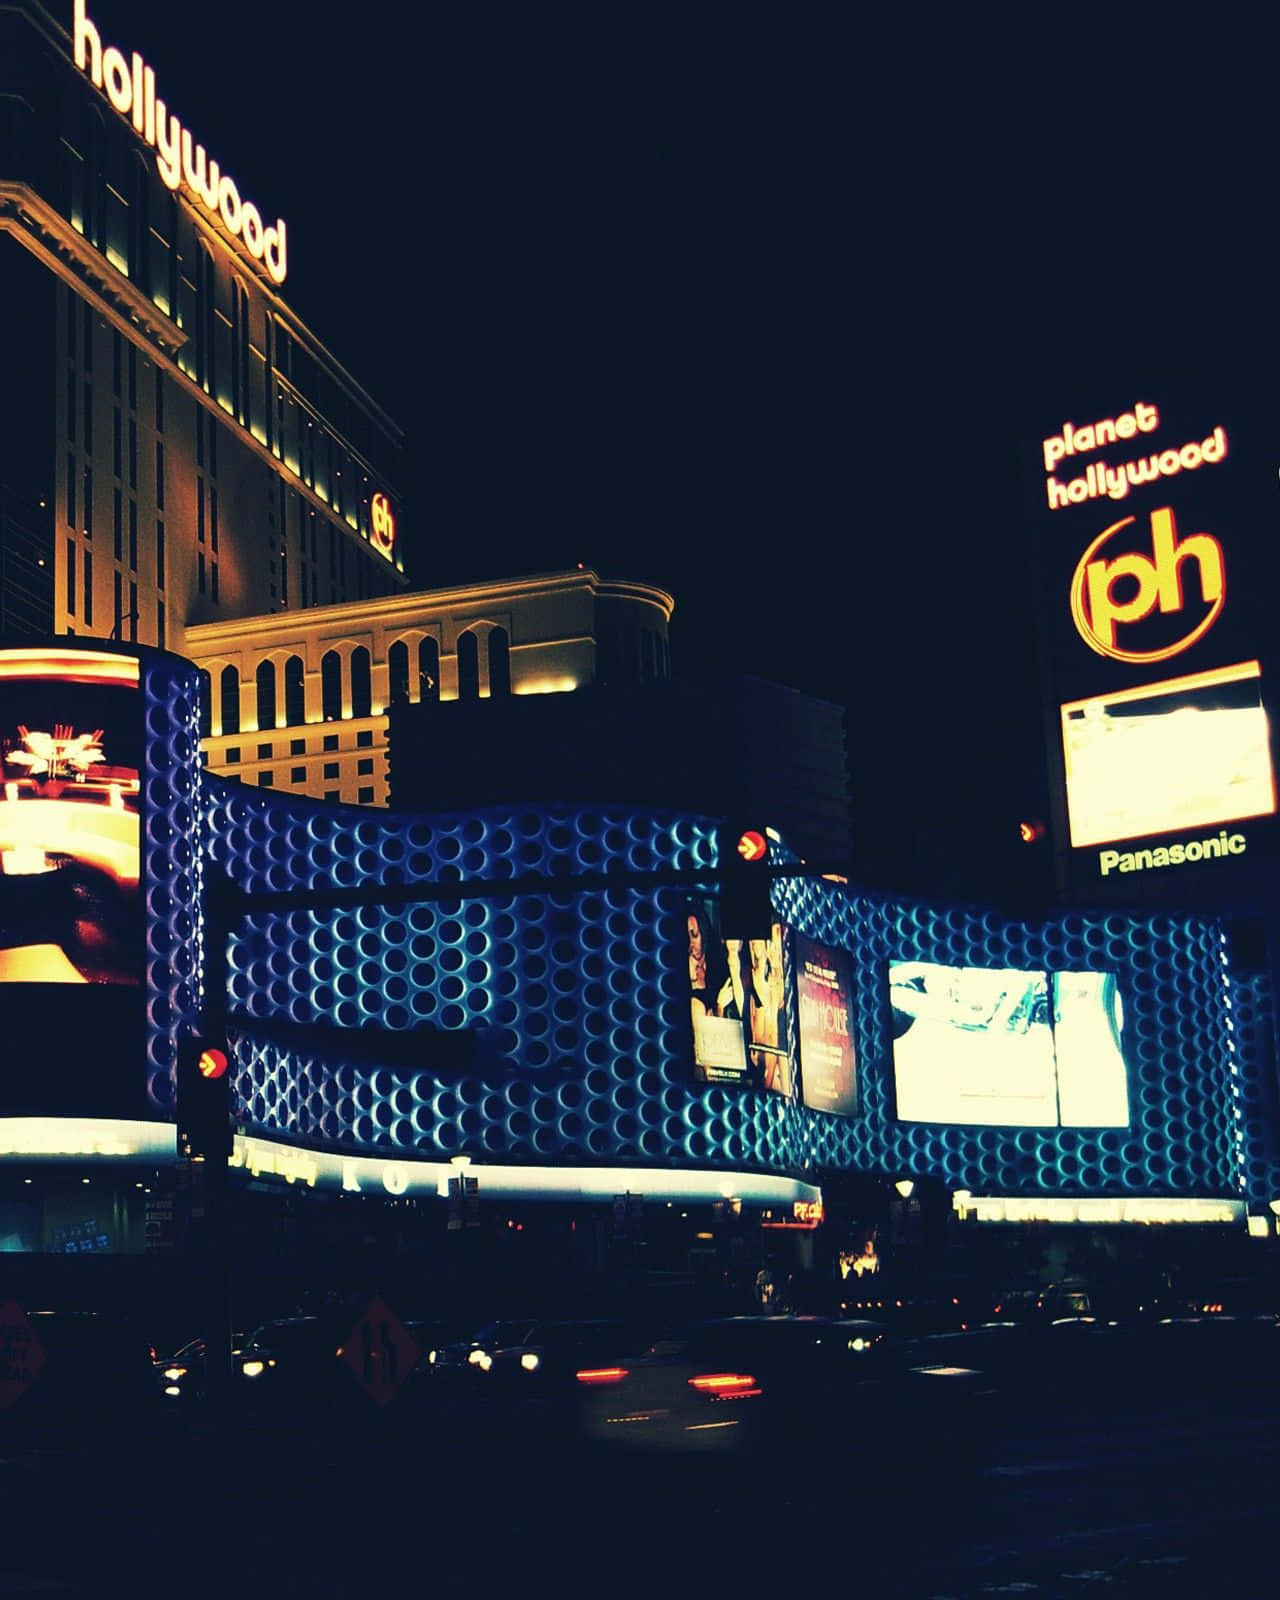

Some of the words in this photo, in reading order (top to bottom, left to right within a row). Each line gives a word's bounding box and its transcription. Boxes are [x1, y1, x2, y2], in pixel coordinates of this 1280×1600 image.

[73, 0, 286, 285] hollywood
[1043, 402, 1158, 472] planet
[1046, 427, 1227, 509] hollywood
[1085, 506, 1224, 650] ph
[1099, 831, 1247, 876] Panasonic
